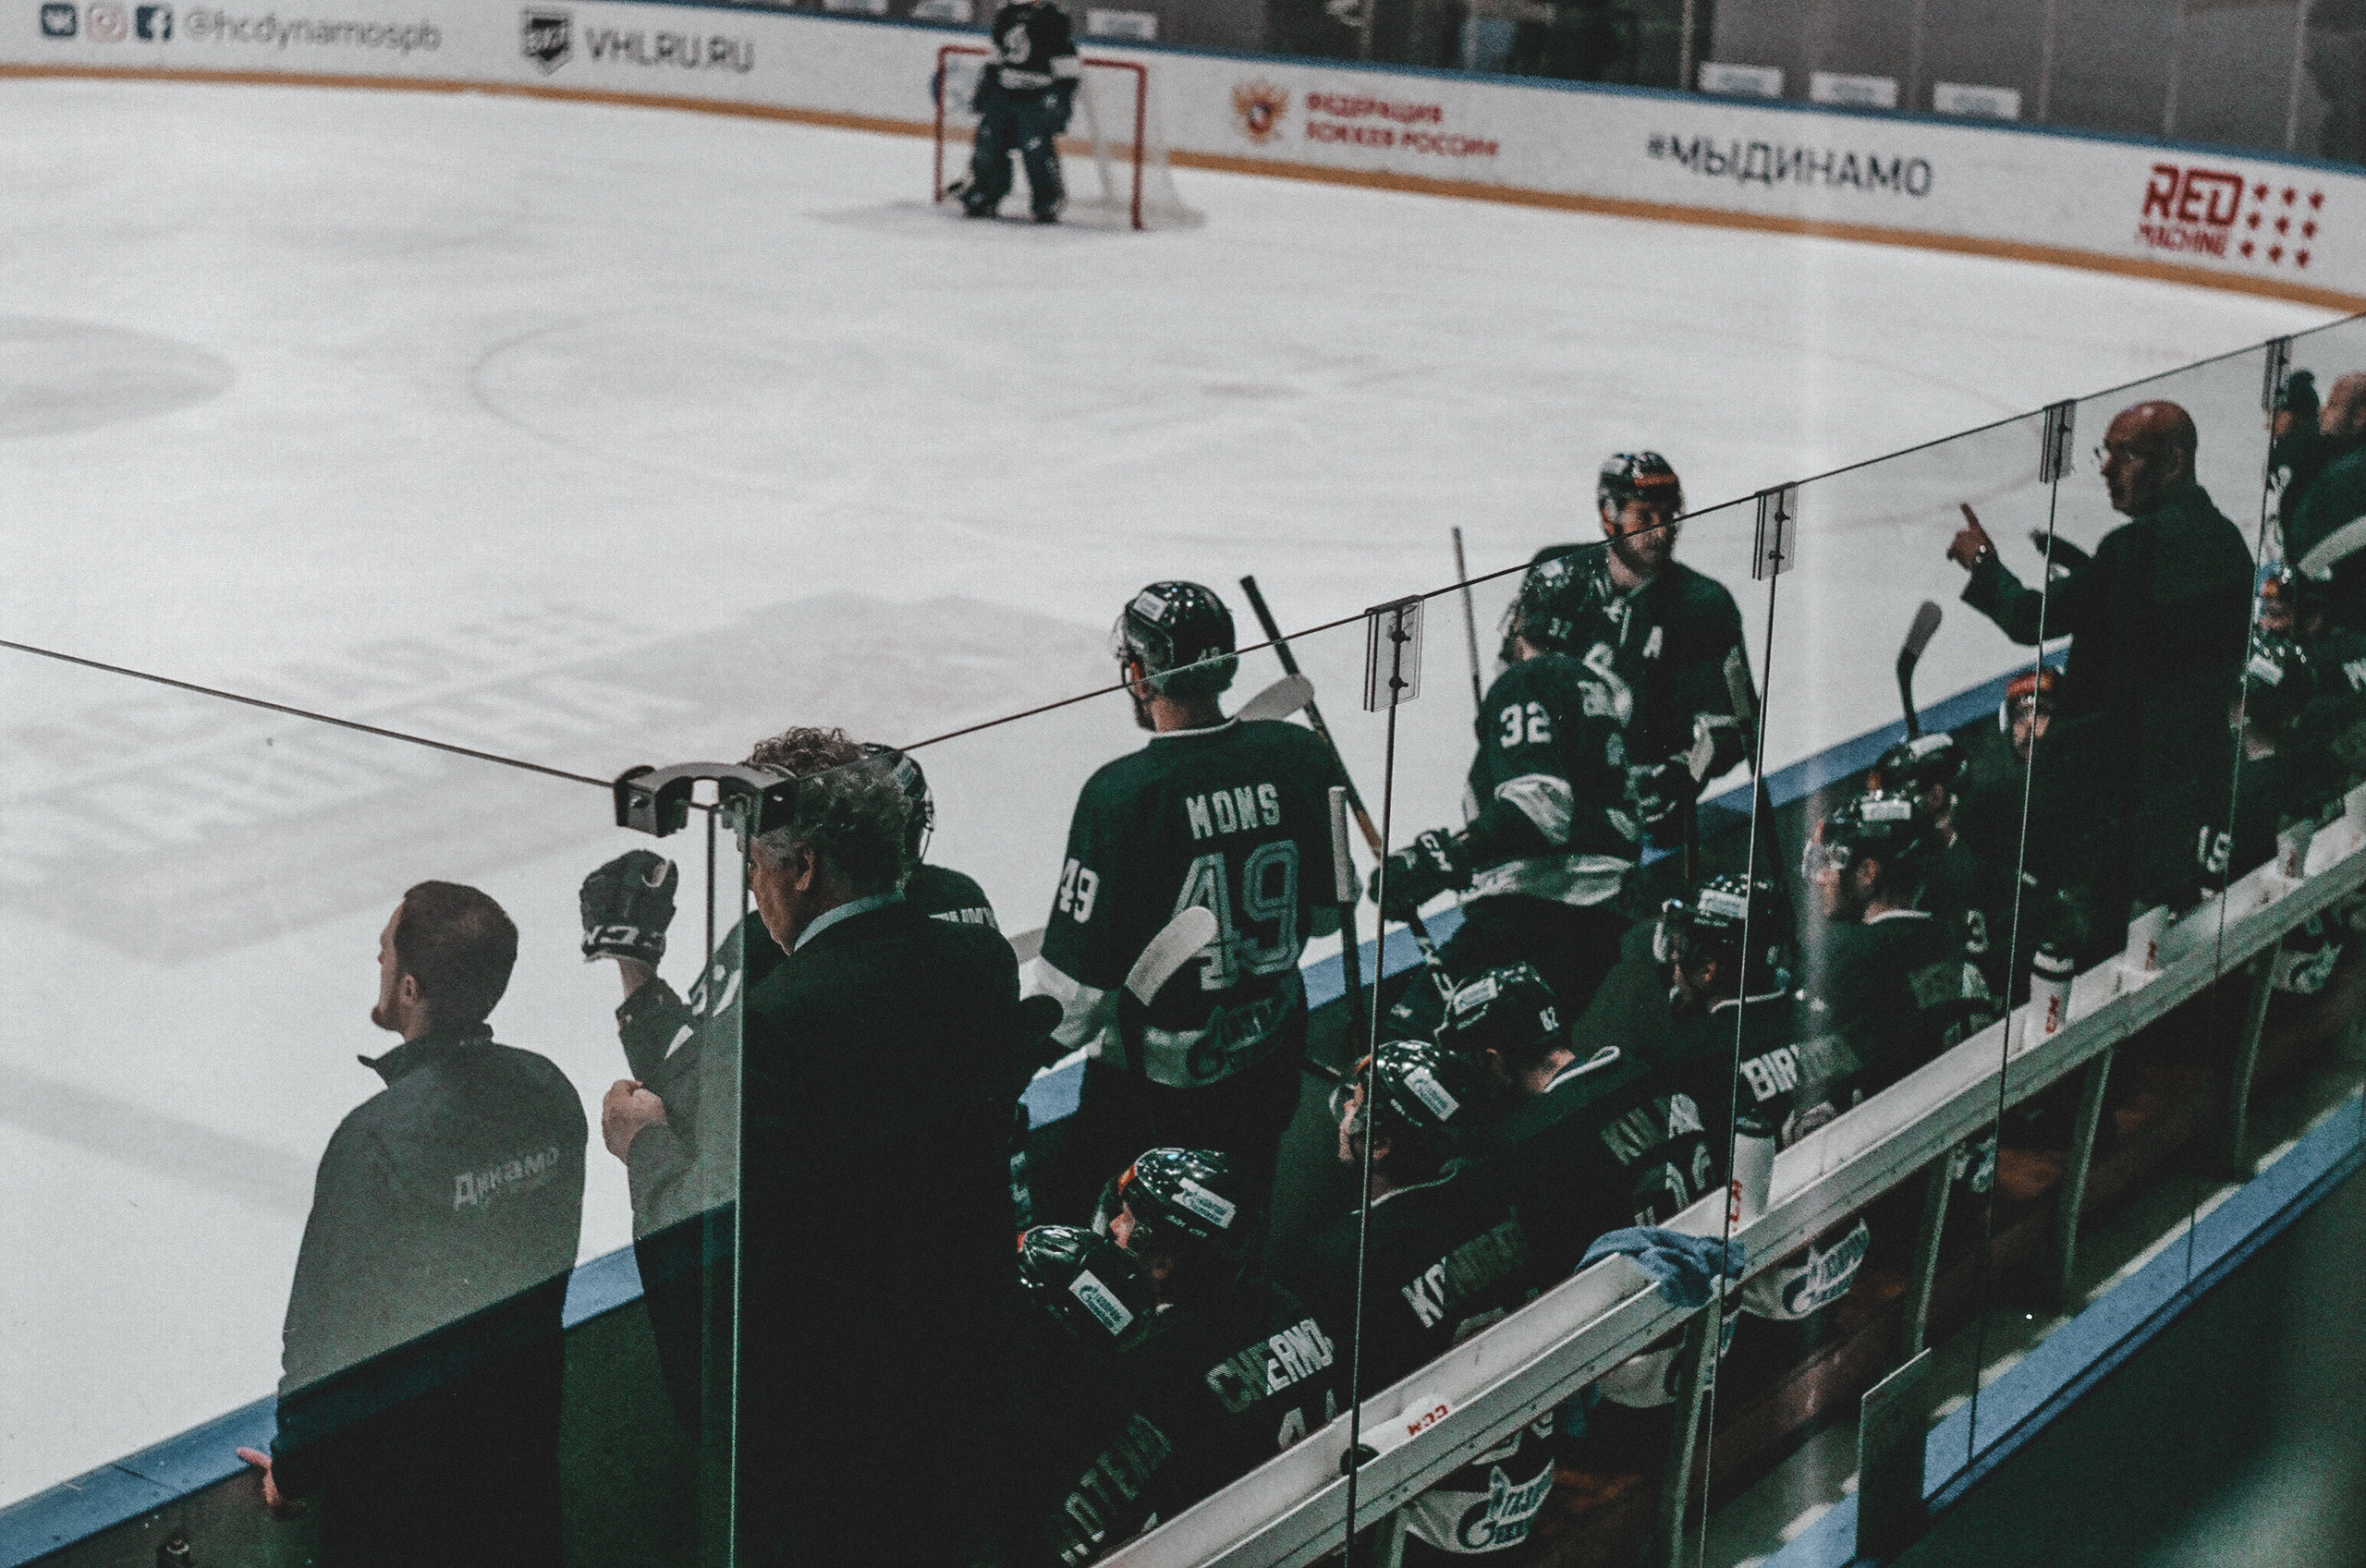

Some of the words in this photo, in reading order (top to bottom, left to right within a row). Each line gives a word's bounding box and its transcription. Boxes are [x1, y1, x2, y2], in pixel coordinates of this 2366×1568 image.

[188, 7, 443, 54] @hcdynamospb
[1647, 131, 1934, 197] #МЫДИНАМО
[2142, 162, 2245, 226] RED
[1642, 625, 1664, 659] A
[1499, 699, 1552, 749] 32
[1185, 783, 1281, 840] MONS
[1059, 858, 1100, 924] 49
[1168, 839, 1299, 991] 49
